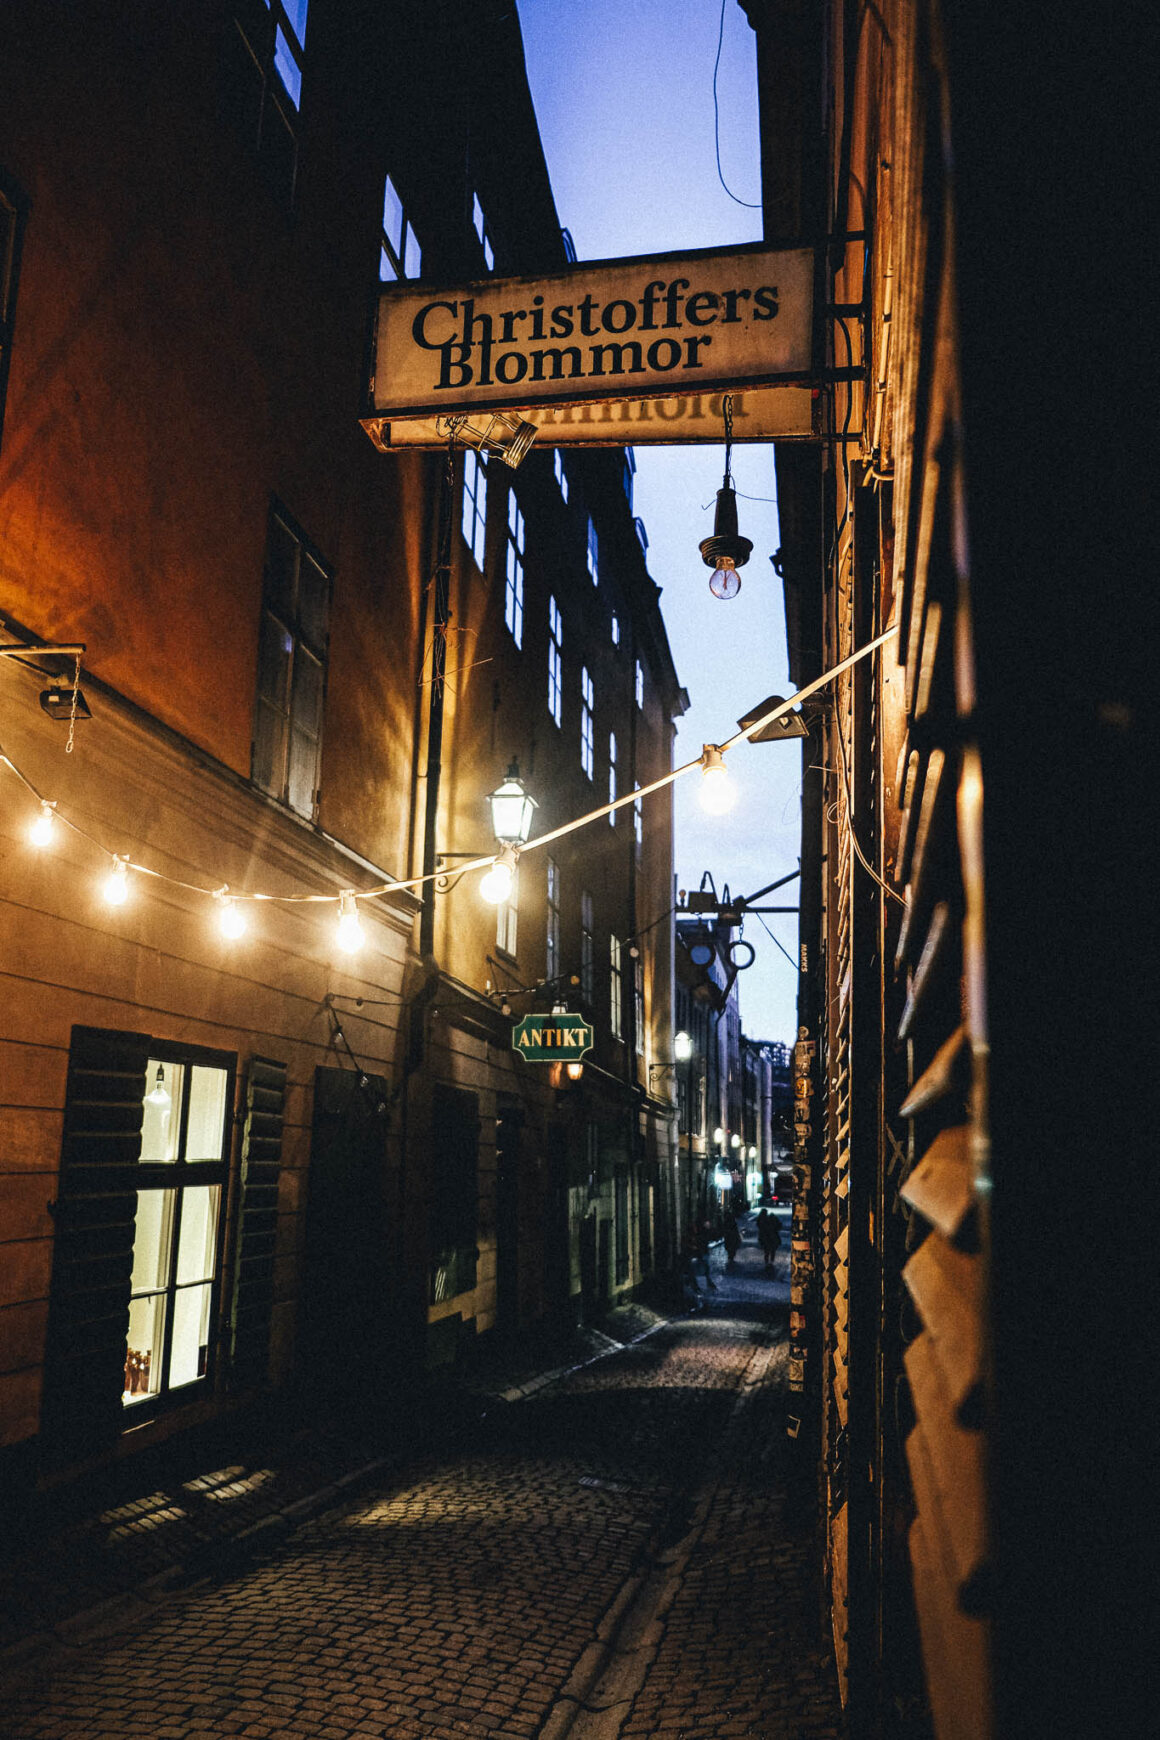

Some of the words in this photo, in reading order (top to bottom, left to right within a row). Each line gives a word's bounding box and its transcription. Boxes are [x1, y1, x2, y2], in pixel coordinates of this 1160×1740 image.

[411, 278, 780, 351] Christoffers
[433, 334, 712, 389] Blommor
[518, 1028, 589, 1047] ANTIKT
